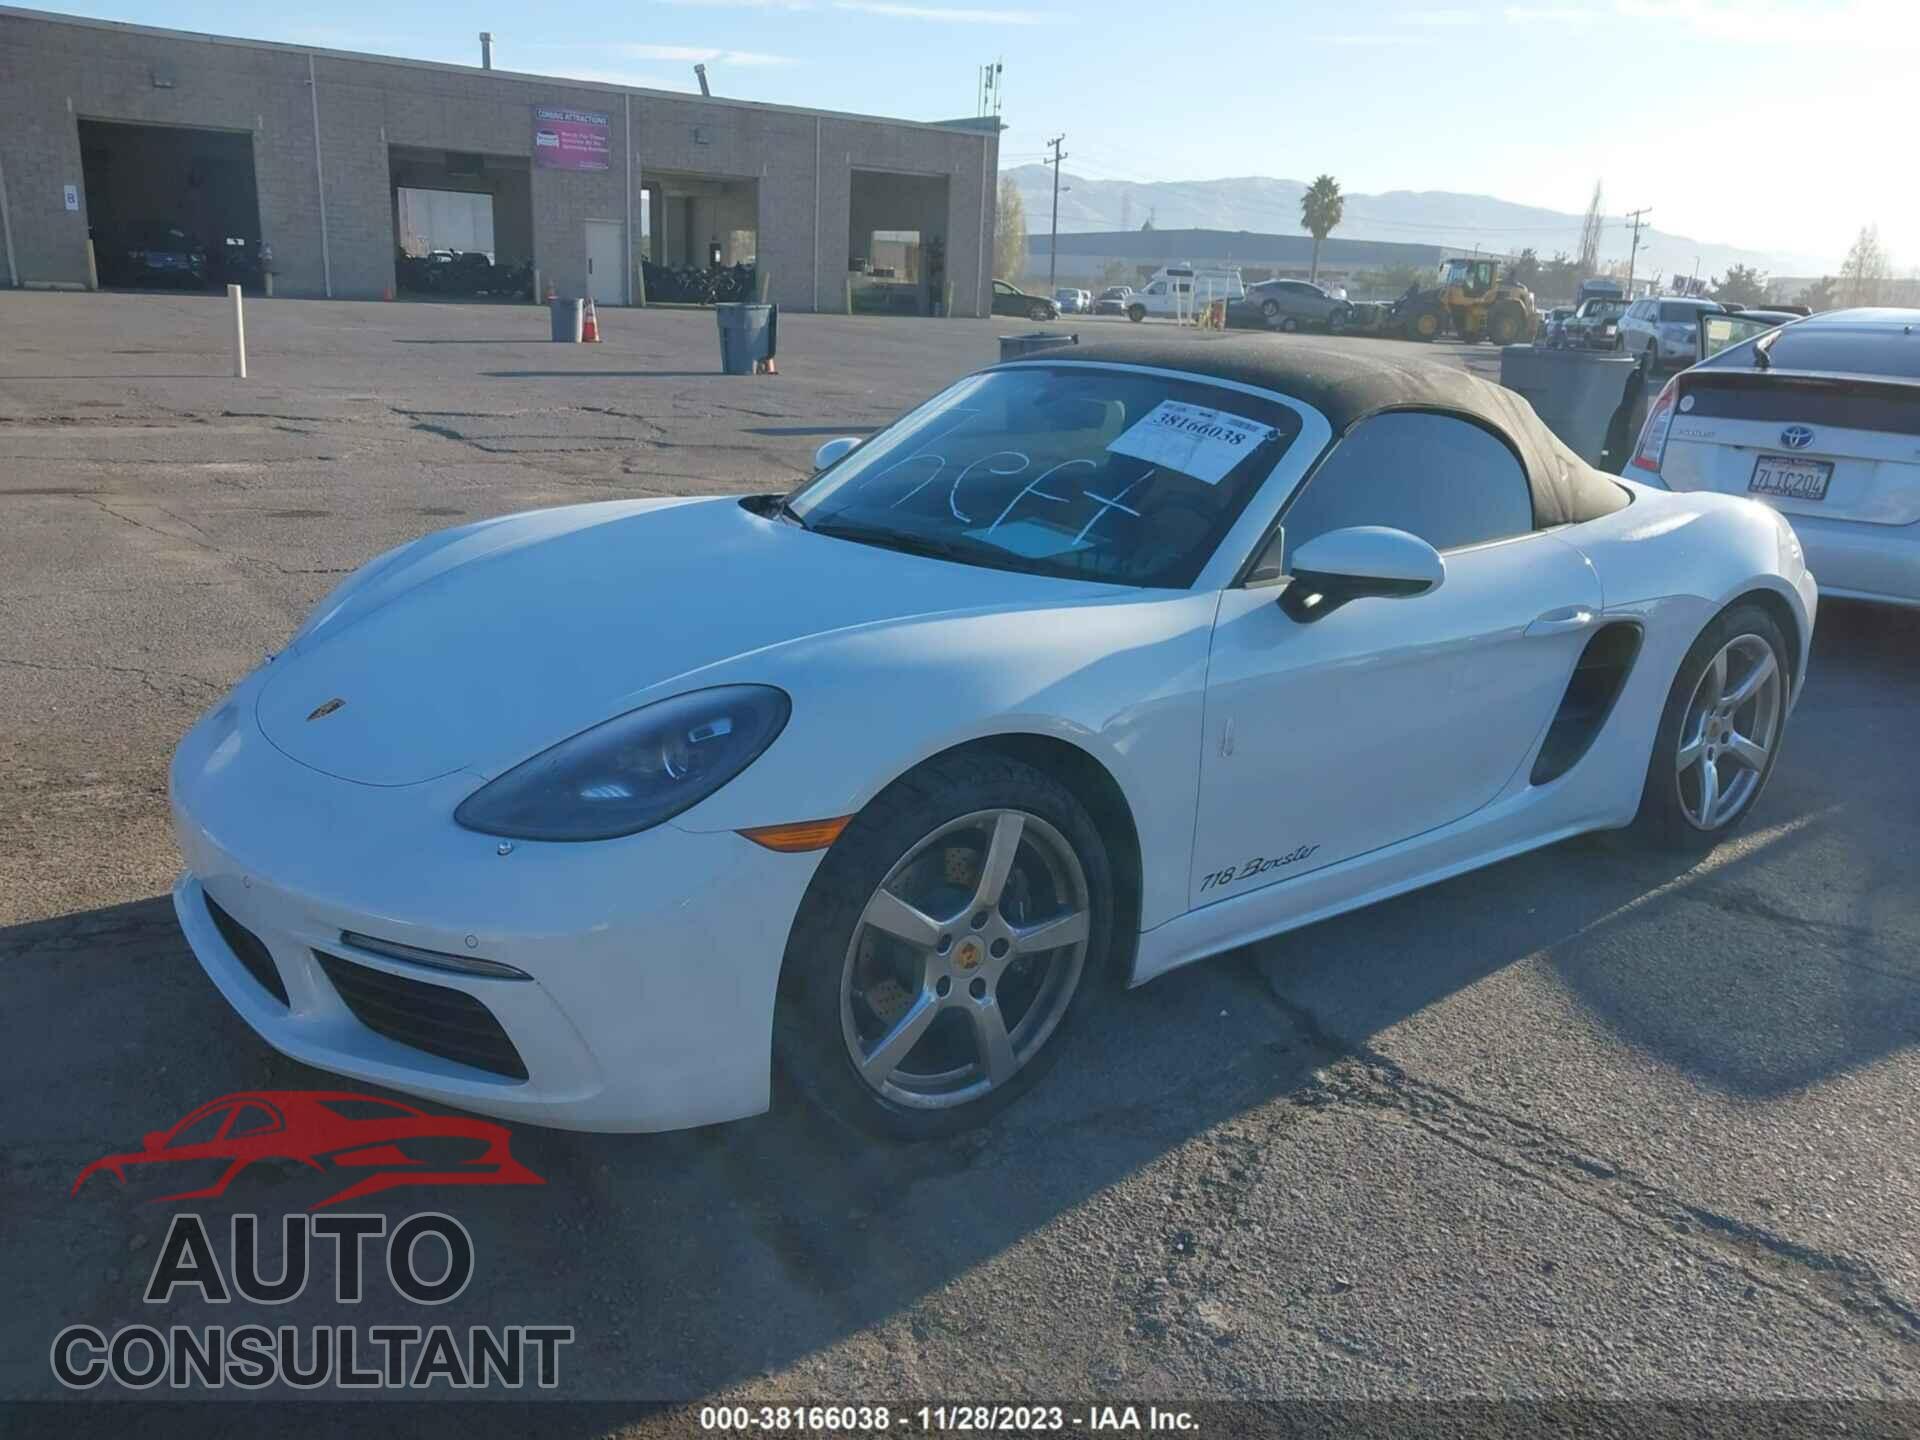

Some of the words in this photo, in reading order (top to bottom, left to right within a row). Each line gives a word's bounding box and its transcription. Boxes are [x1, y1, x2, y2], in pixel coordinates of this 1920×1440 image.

[538, 111, 563, 121] COMING
[1153, 412, 1247, 446] 38166038
[1200, 866, 1236, 892] 718
[1235, 844, 1321, 880] Boxster
